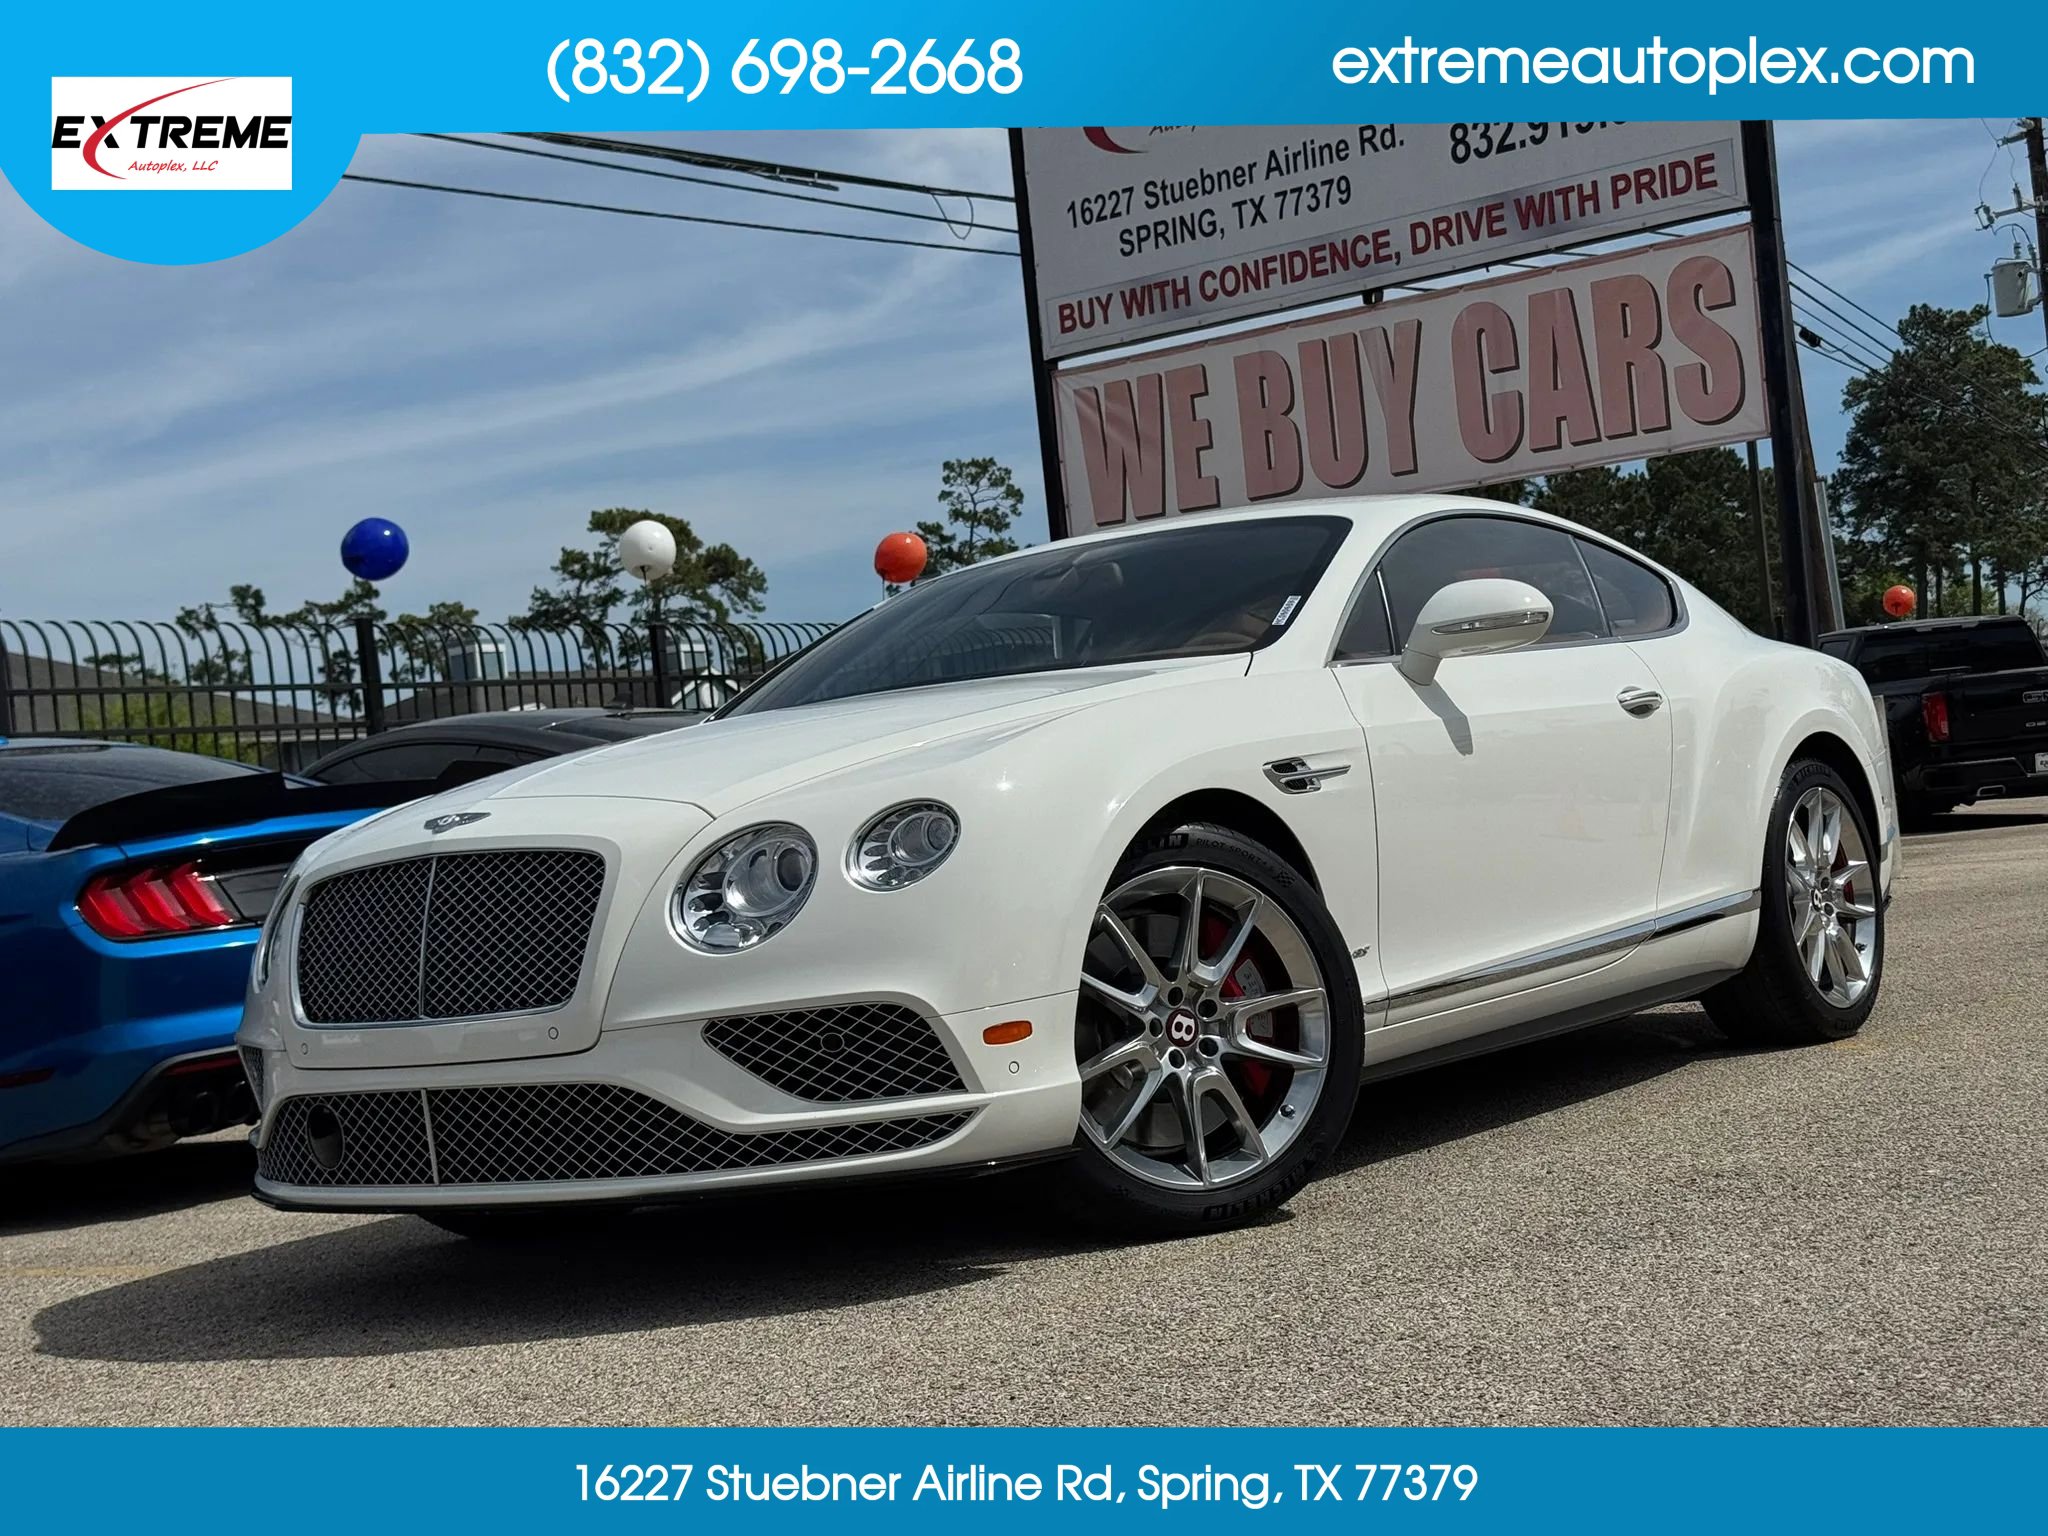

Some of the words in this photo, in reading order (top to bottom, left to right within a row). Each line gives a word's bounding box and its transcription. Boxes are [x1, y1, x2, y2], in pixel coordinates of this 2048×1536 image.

[1058, 293, 1114, 334] BUY
[1120, 275, 1190, 320] WITH
[1199, 229, 1402, 301] CONFIDENCE,
[1410, 202, 1507, 255] DRIVE
[1513, 180, 1601, 231] WITH
[1610, 153, 1718, 209] PRIDE
[1067, 187, 1135, 229] 16227
[1143, 159, 1257, 210] Stuebner
[1264, 138, 1350, 181] Airline
[1358, 123, 1405, 156] Rd.
[1119, 208, 1226, 257] SPRING,
[1231, 195, 1268, 231] TX
[1274, 175, 1352, 220] 77379
[1073, 364, 1220, 526] WE
[1234, 319, 1421, 502] BUY
[1451, 255, 1745, 465] CARS
